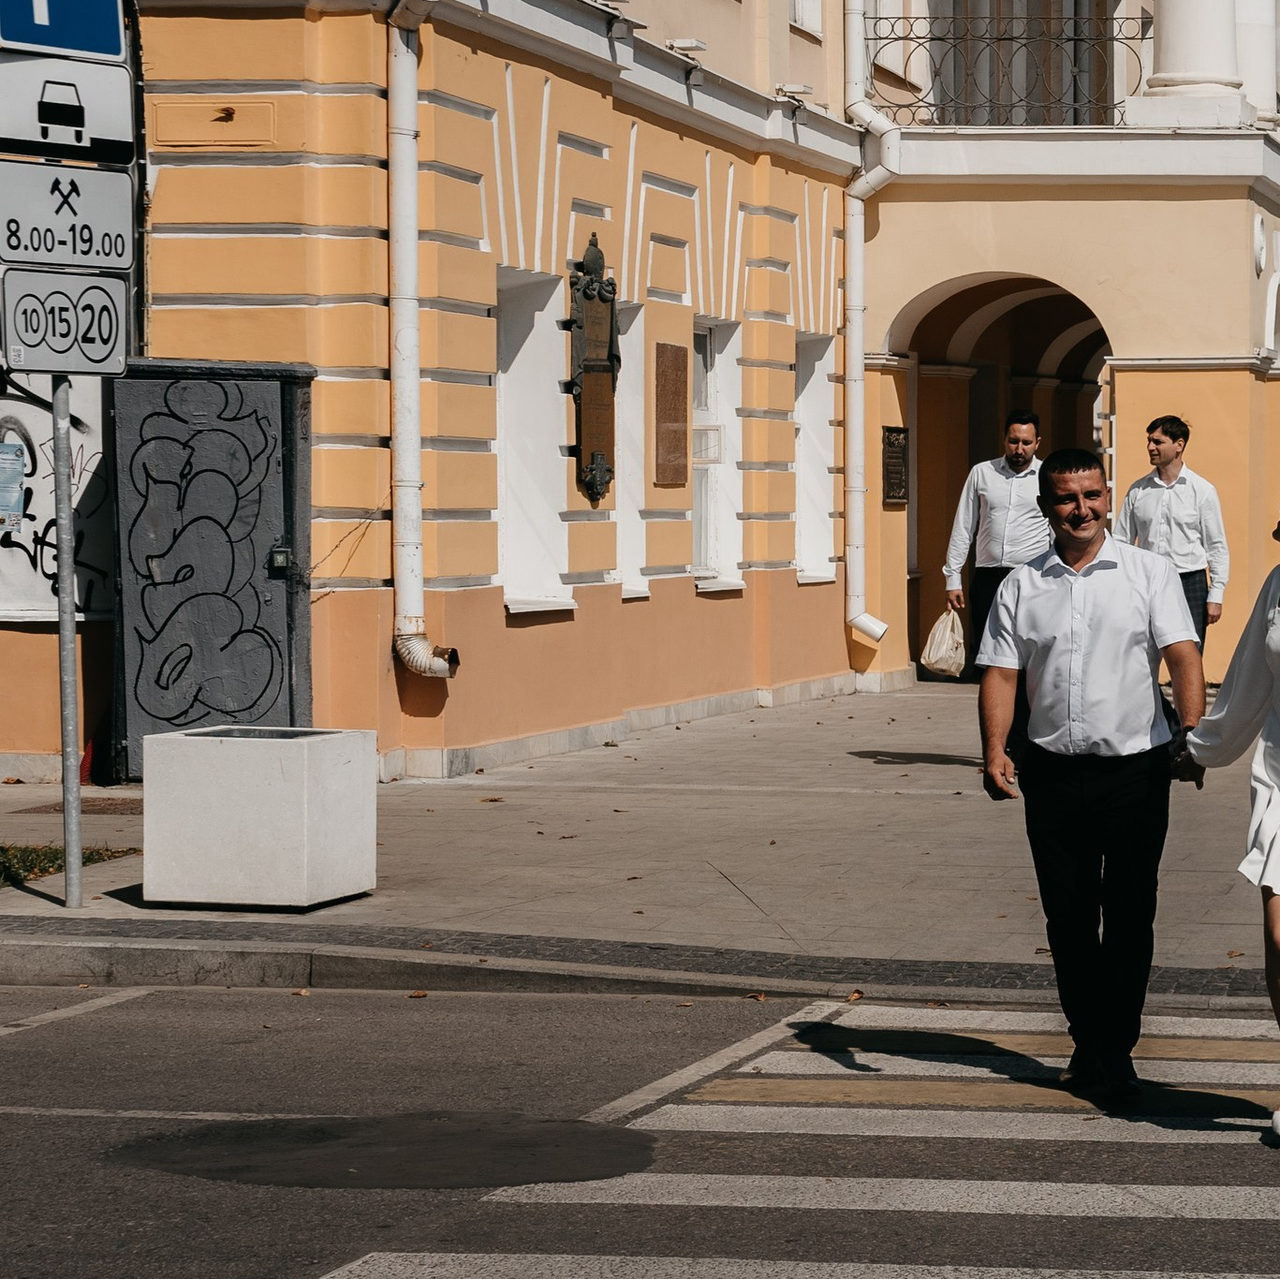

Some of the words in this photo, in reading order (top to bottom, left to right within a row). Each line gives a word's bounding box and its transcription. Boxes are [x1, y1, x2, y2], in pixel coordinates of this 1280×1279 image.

[6, 218, 125, 257] 8.00-19.00
[21, 308, 40, 334] 10
[47, 306, 71, 338] 15
[81, 303, 112, 346] 20
